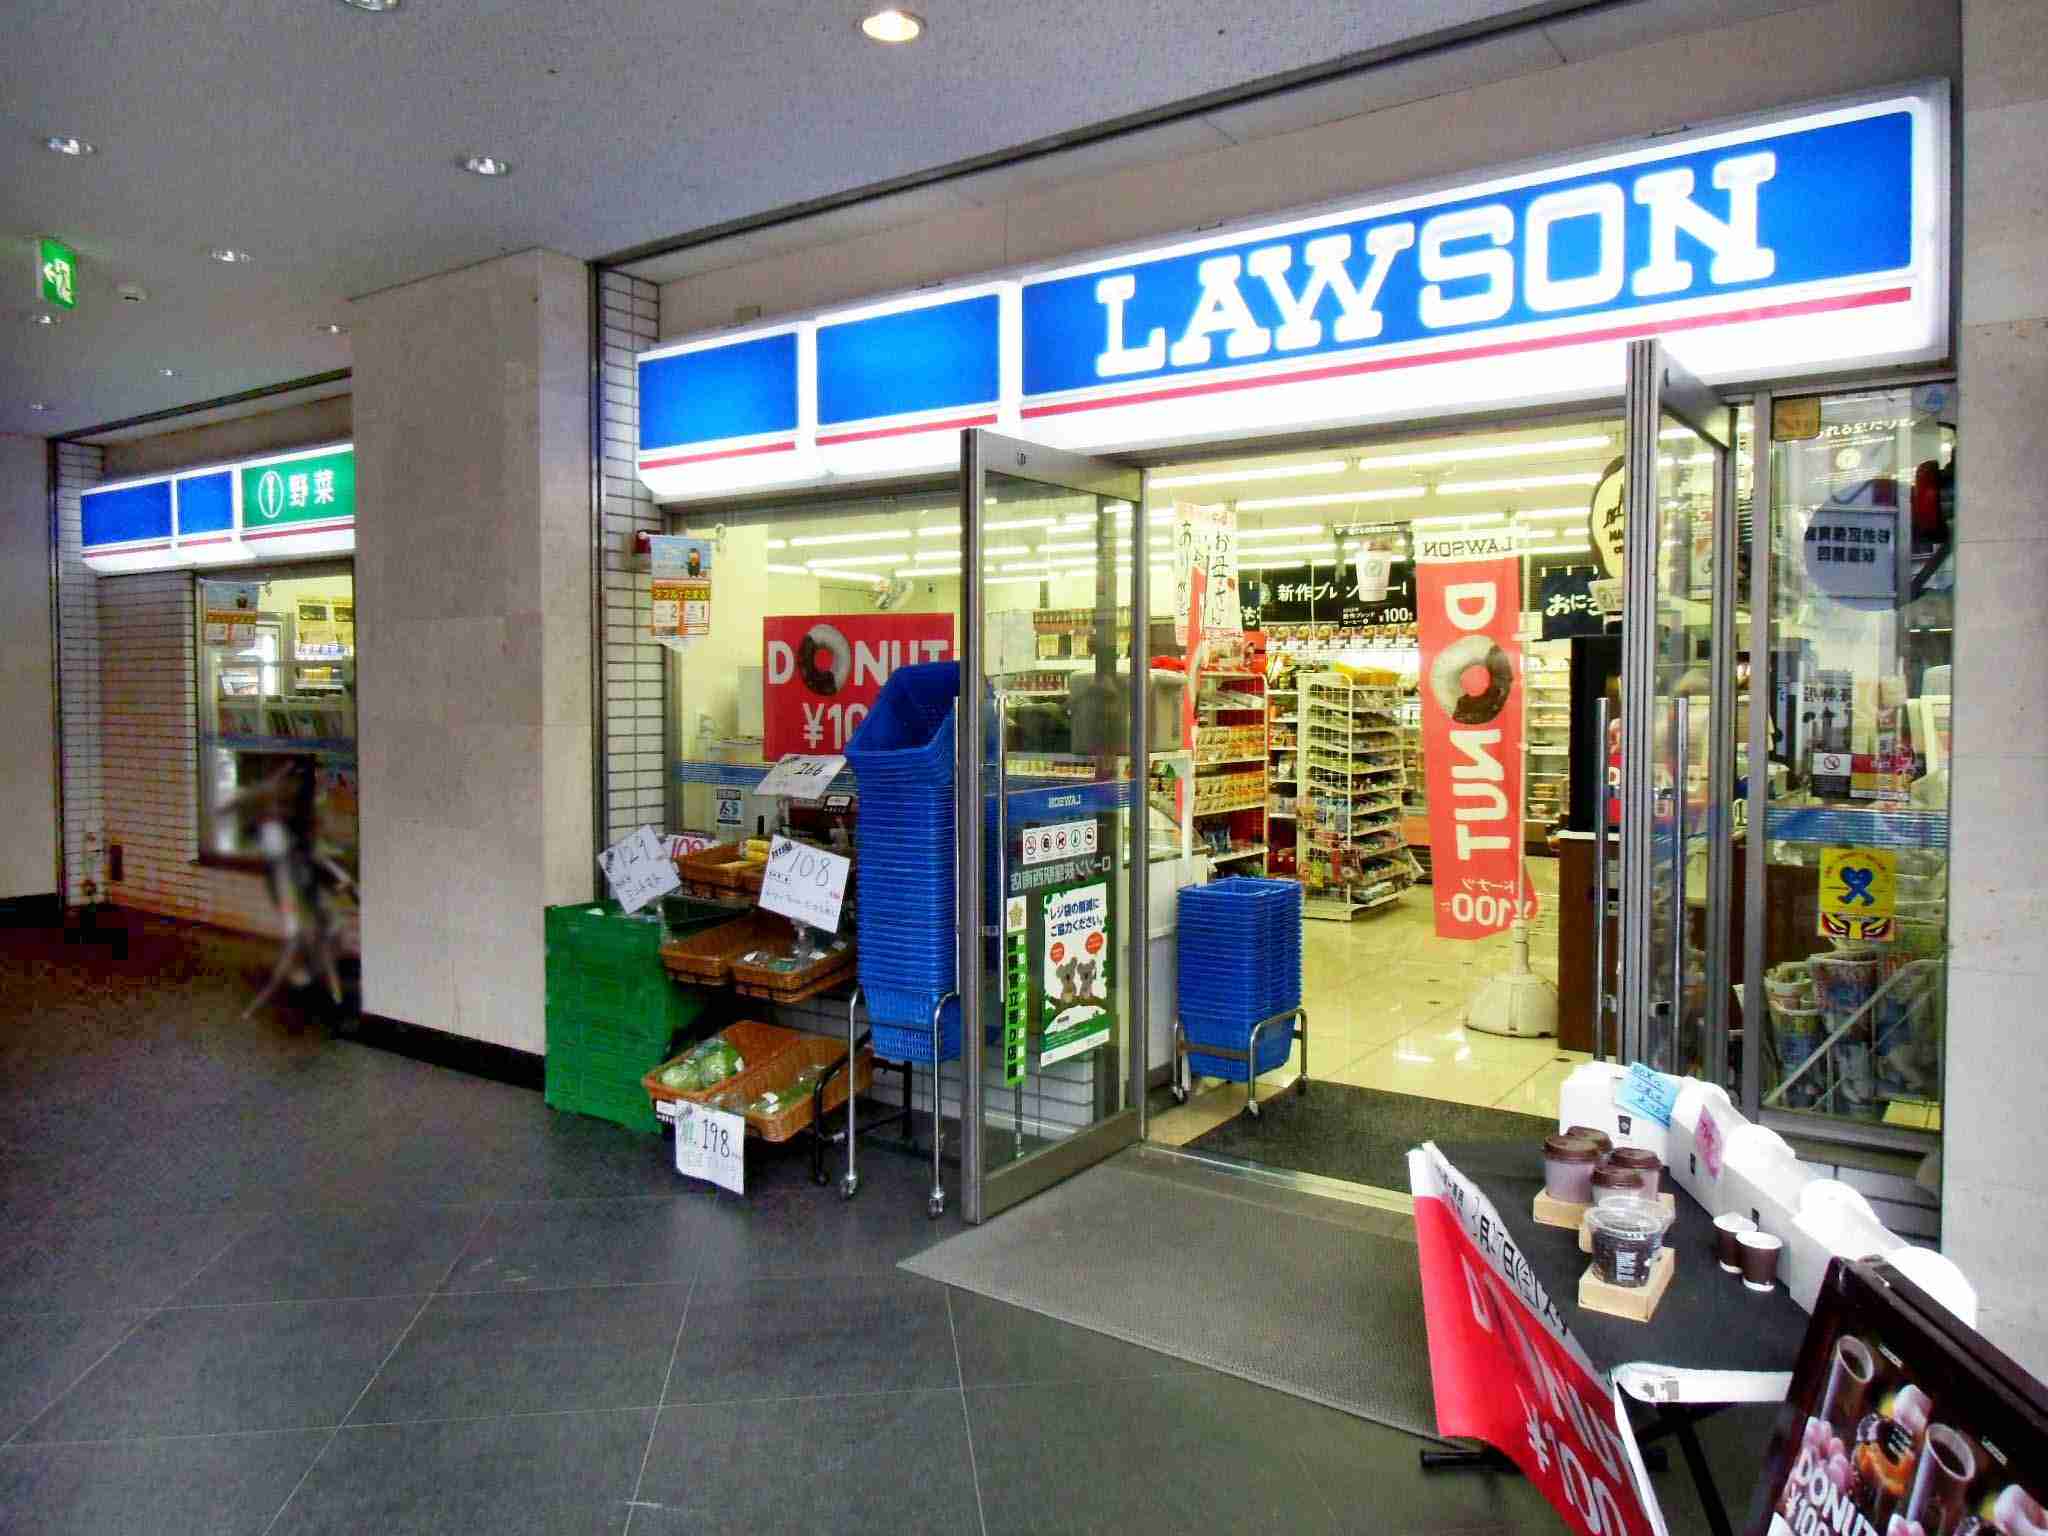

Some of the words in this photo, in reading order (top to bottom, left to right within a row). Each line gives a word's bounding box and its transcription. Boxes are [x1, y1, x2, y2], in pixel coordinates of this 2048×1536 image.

[1095, 150, 1776, 378] LAWSON
[288, 469, 335, 507] 野菜
[802, 702, 868, 750] ¥10
[789, 851, 831, 887] 108
[703, 1118, 730, 1159] 198
